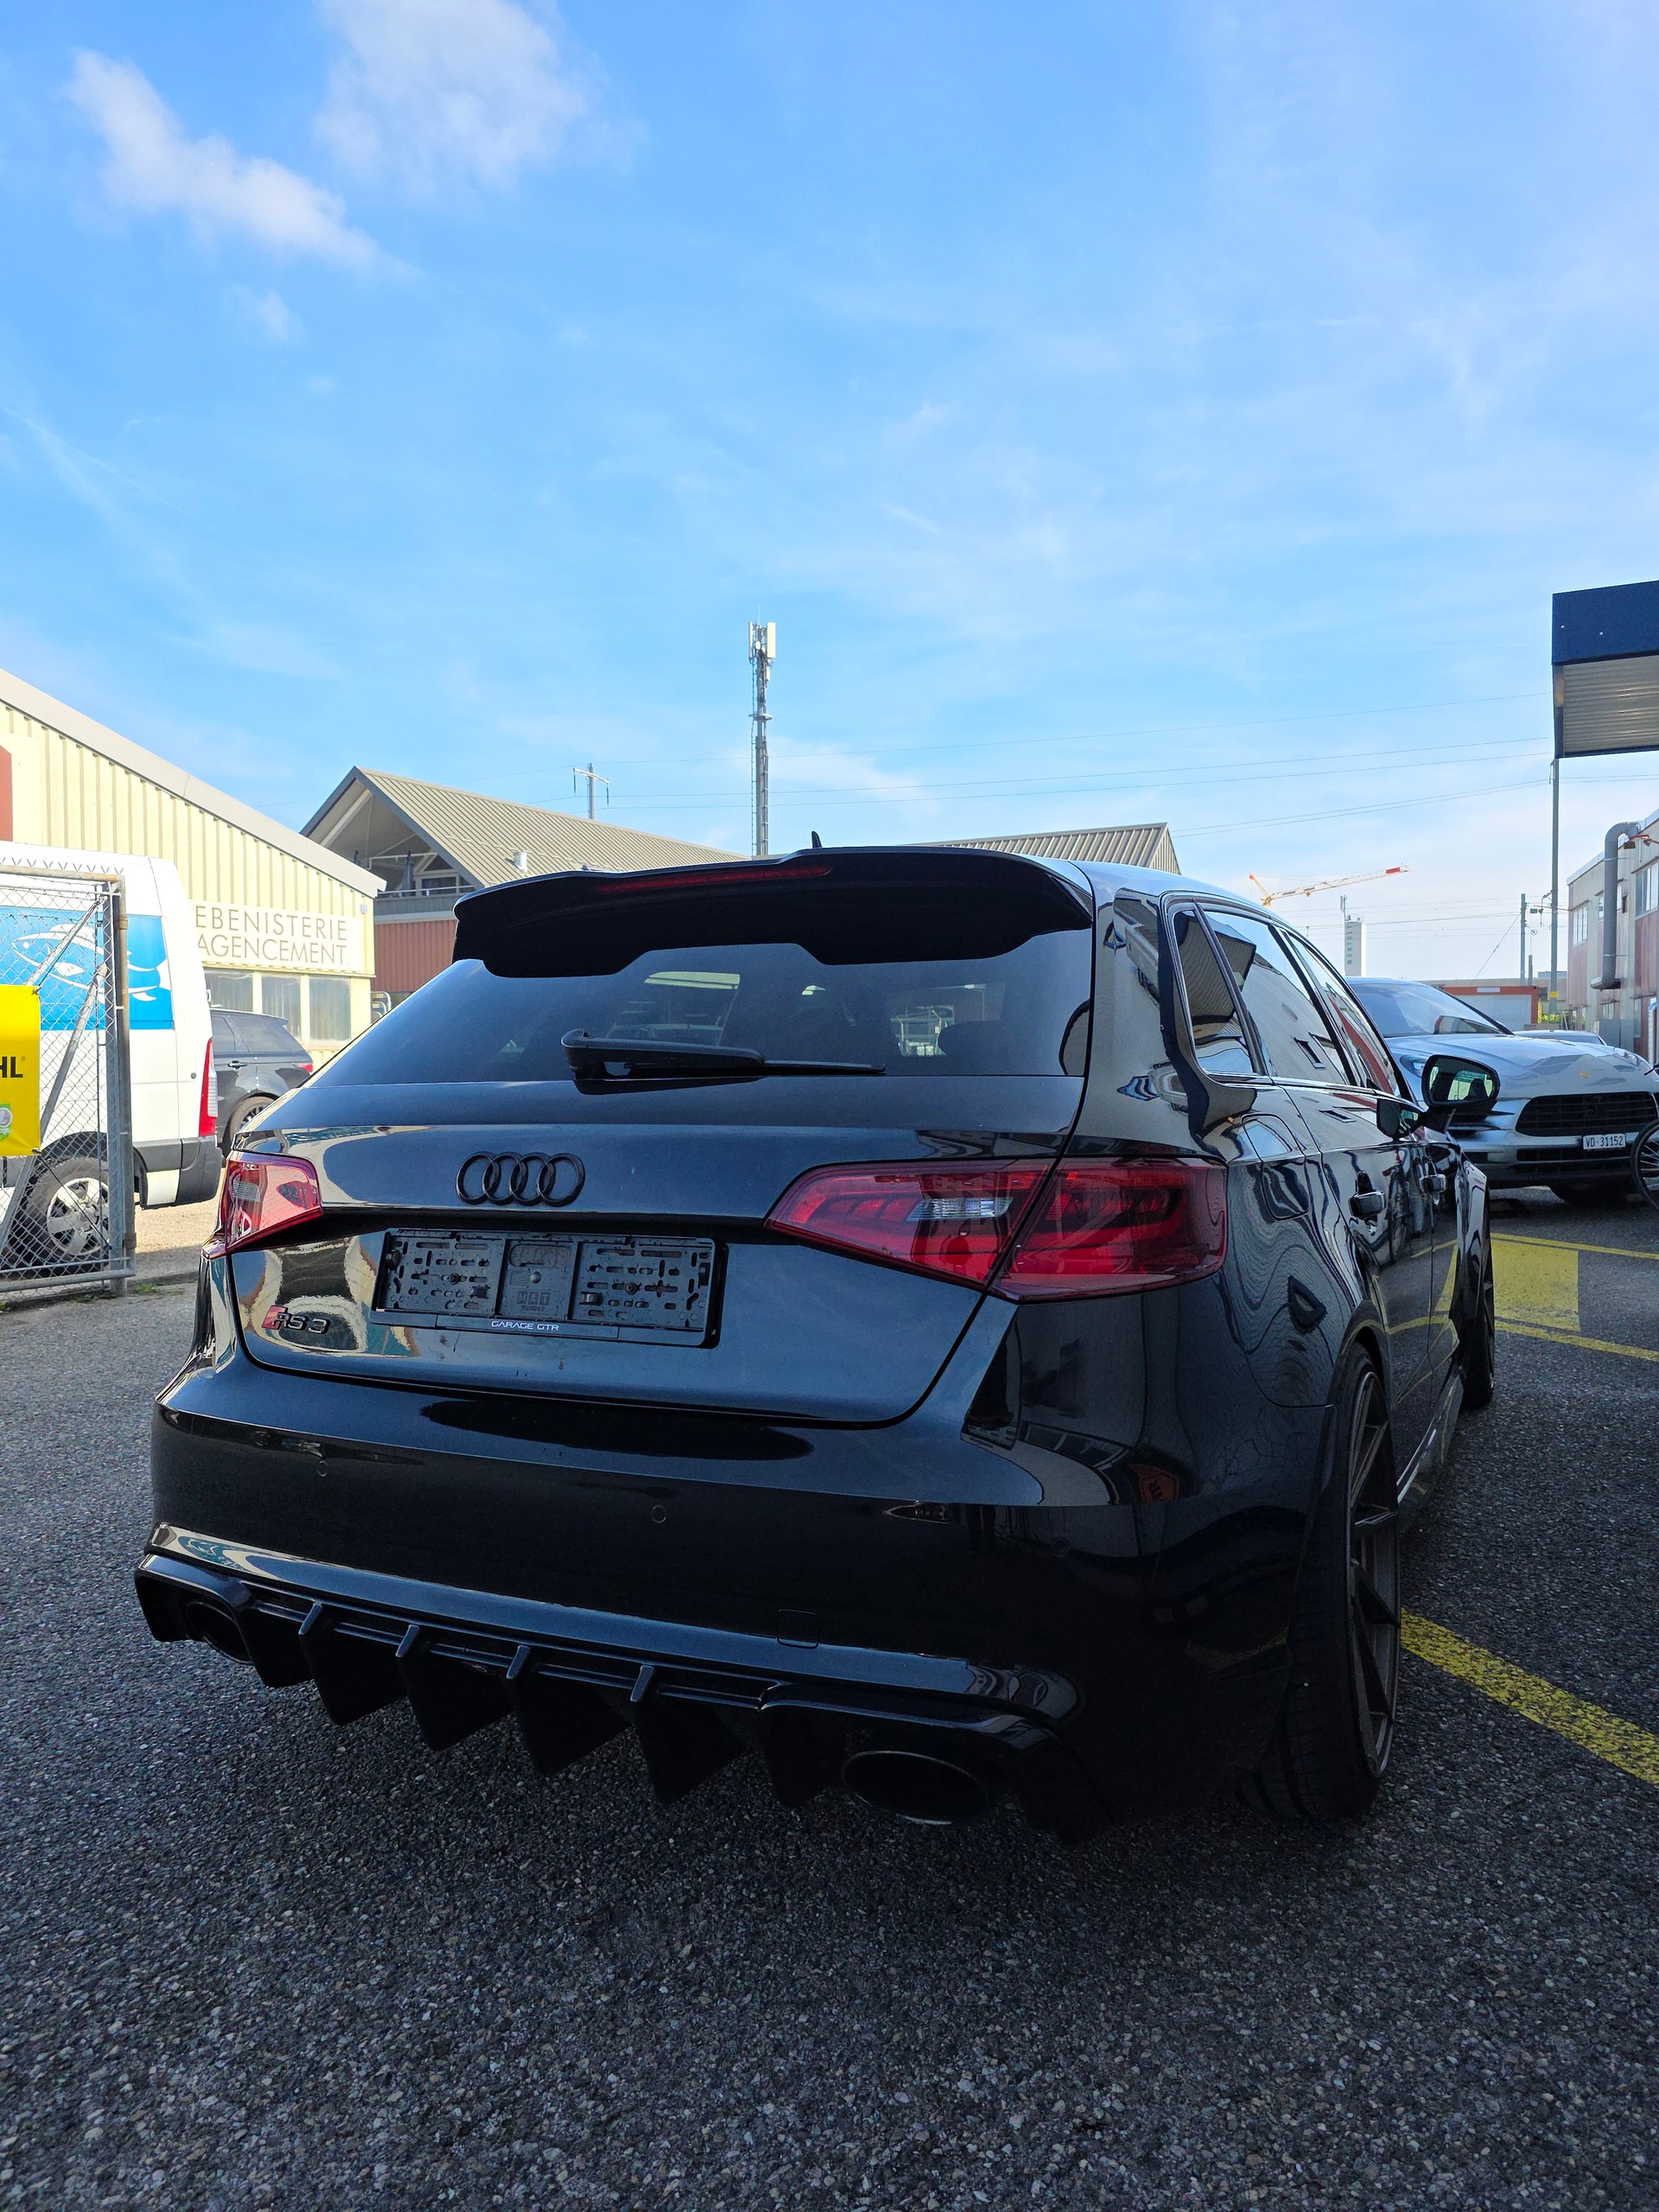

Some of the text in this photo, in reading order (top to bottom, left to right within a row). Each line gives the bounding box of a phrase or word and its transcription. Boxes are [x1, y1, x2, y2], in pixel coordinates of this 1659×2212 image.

[195, 905, 346, 940] EBENISTERIE
[198, 933, 346, 964] AGENCEMENT
[491, 1320, 534, 1330] GARAGE
